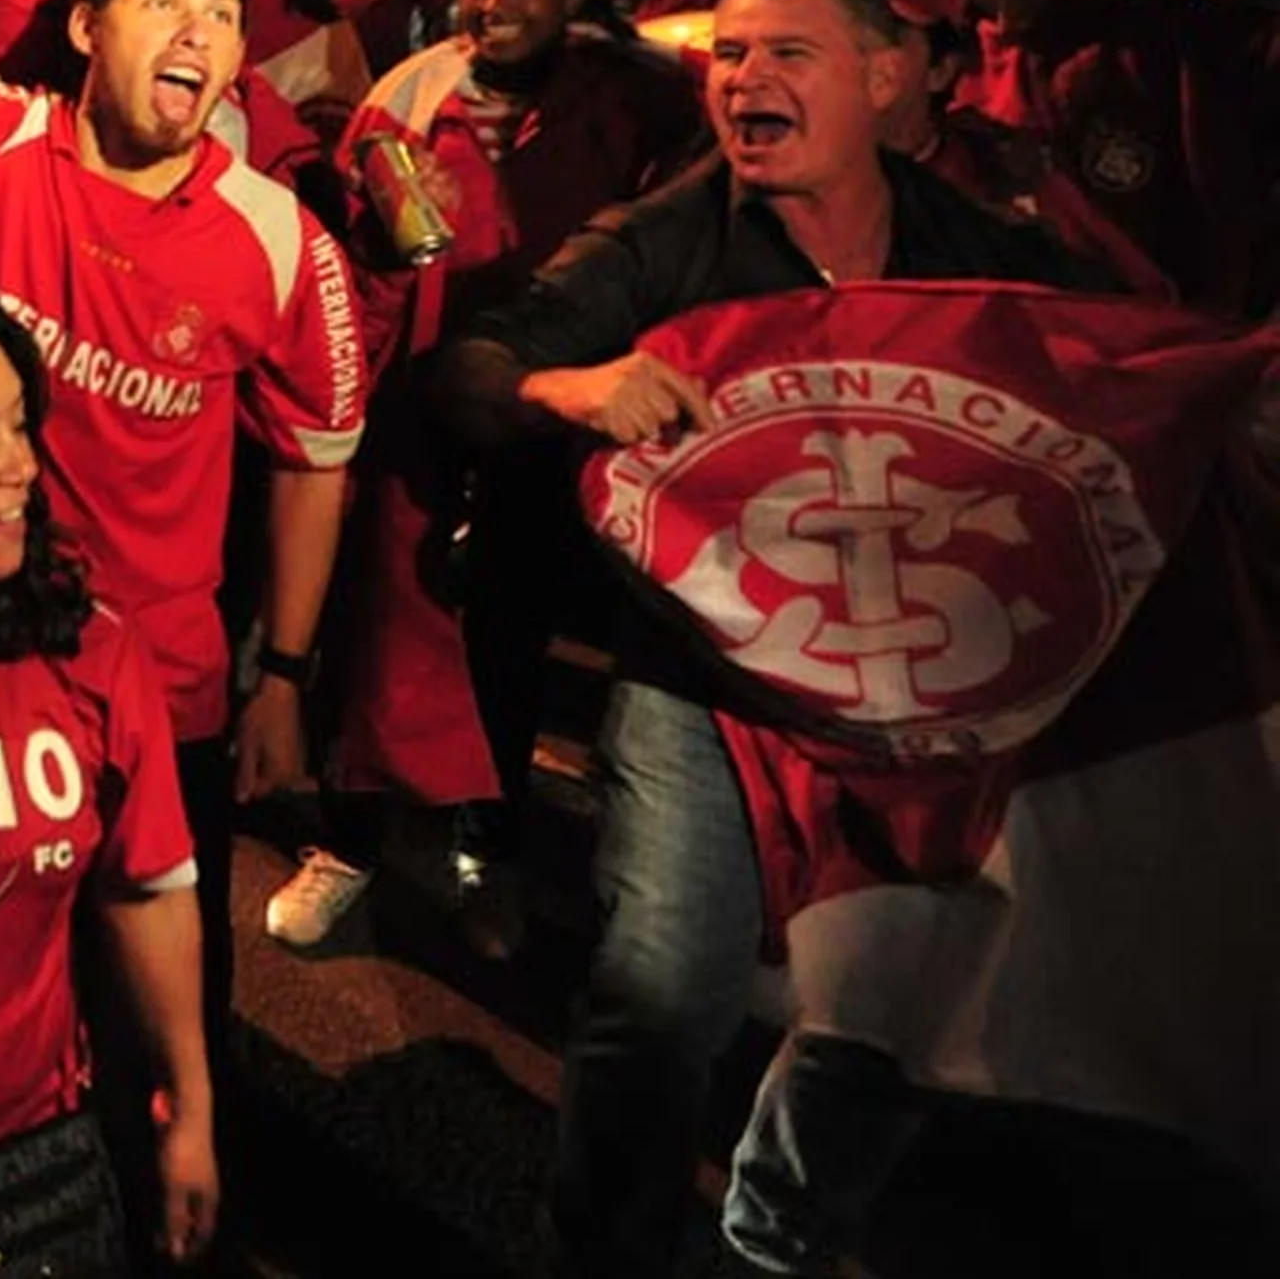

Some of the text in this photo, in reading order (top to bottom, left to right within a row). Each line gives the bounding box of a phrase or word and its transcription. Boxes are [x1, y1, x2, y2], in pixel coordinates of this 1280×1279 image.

[309, 232, 365, 428] INTERNACIONAL
[613, 366, 1158, 593] INERNACIONAL
[32, 838, 75, 876] FC
